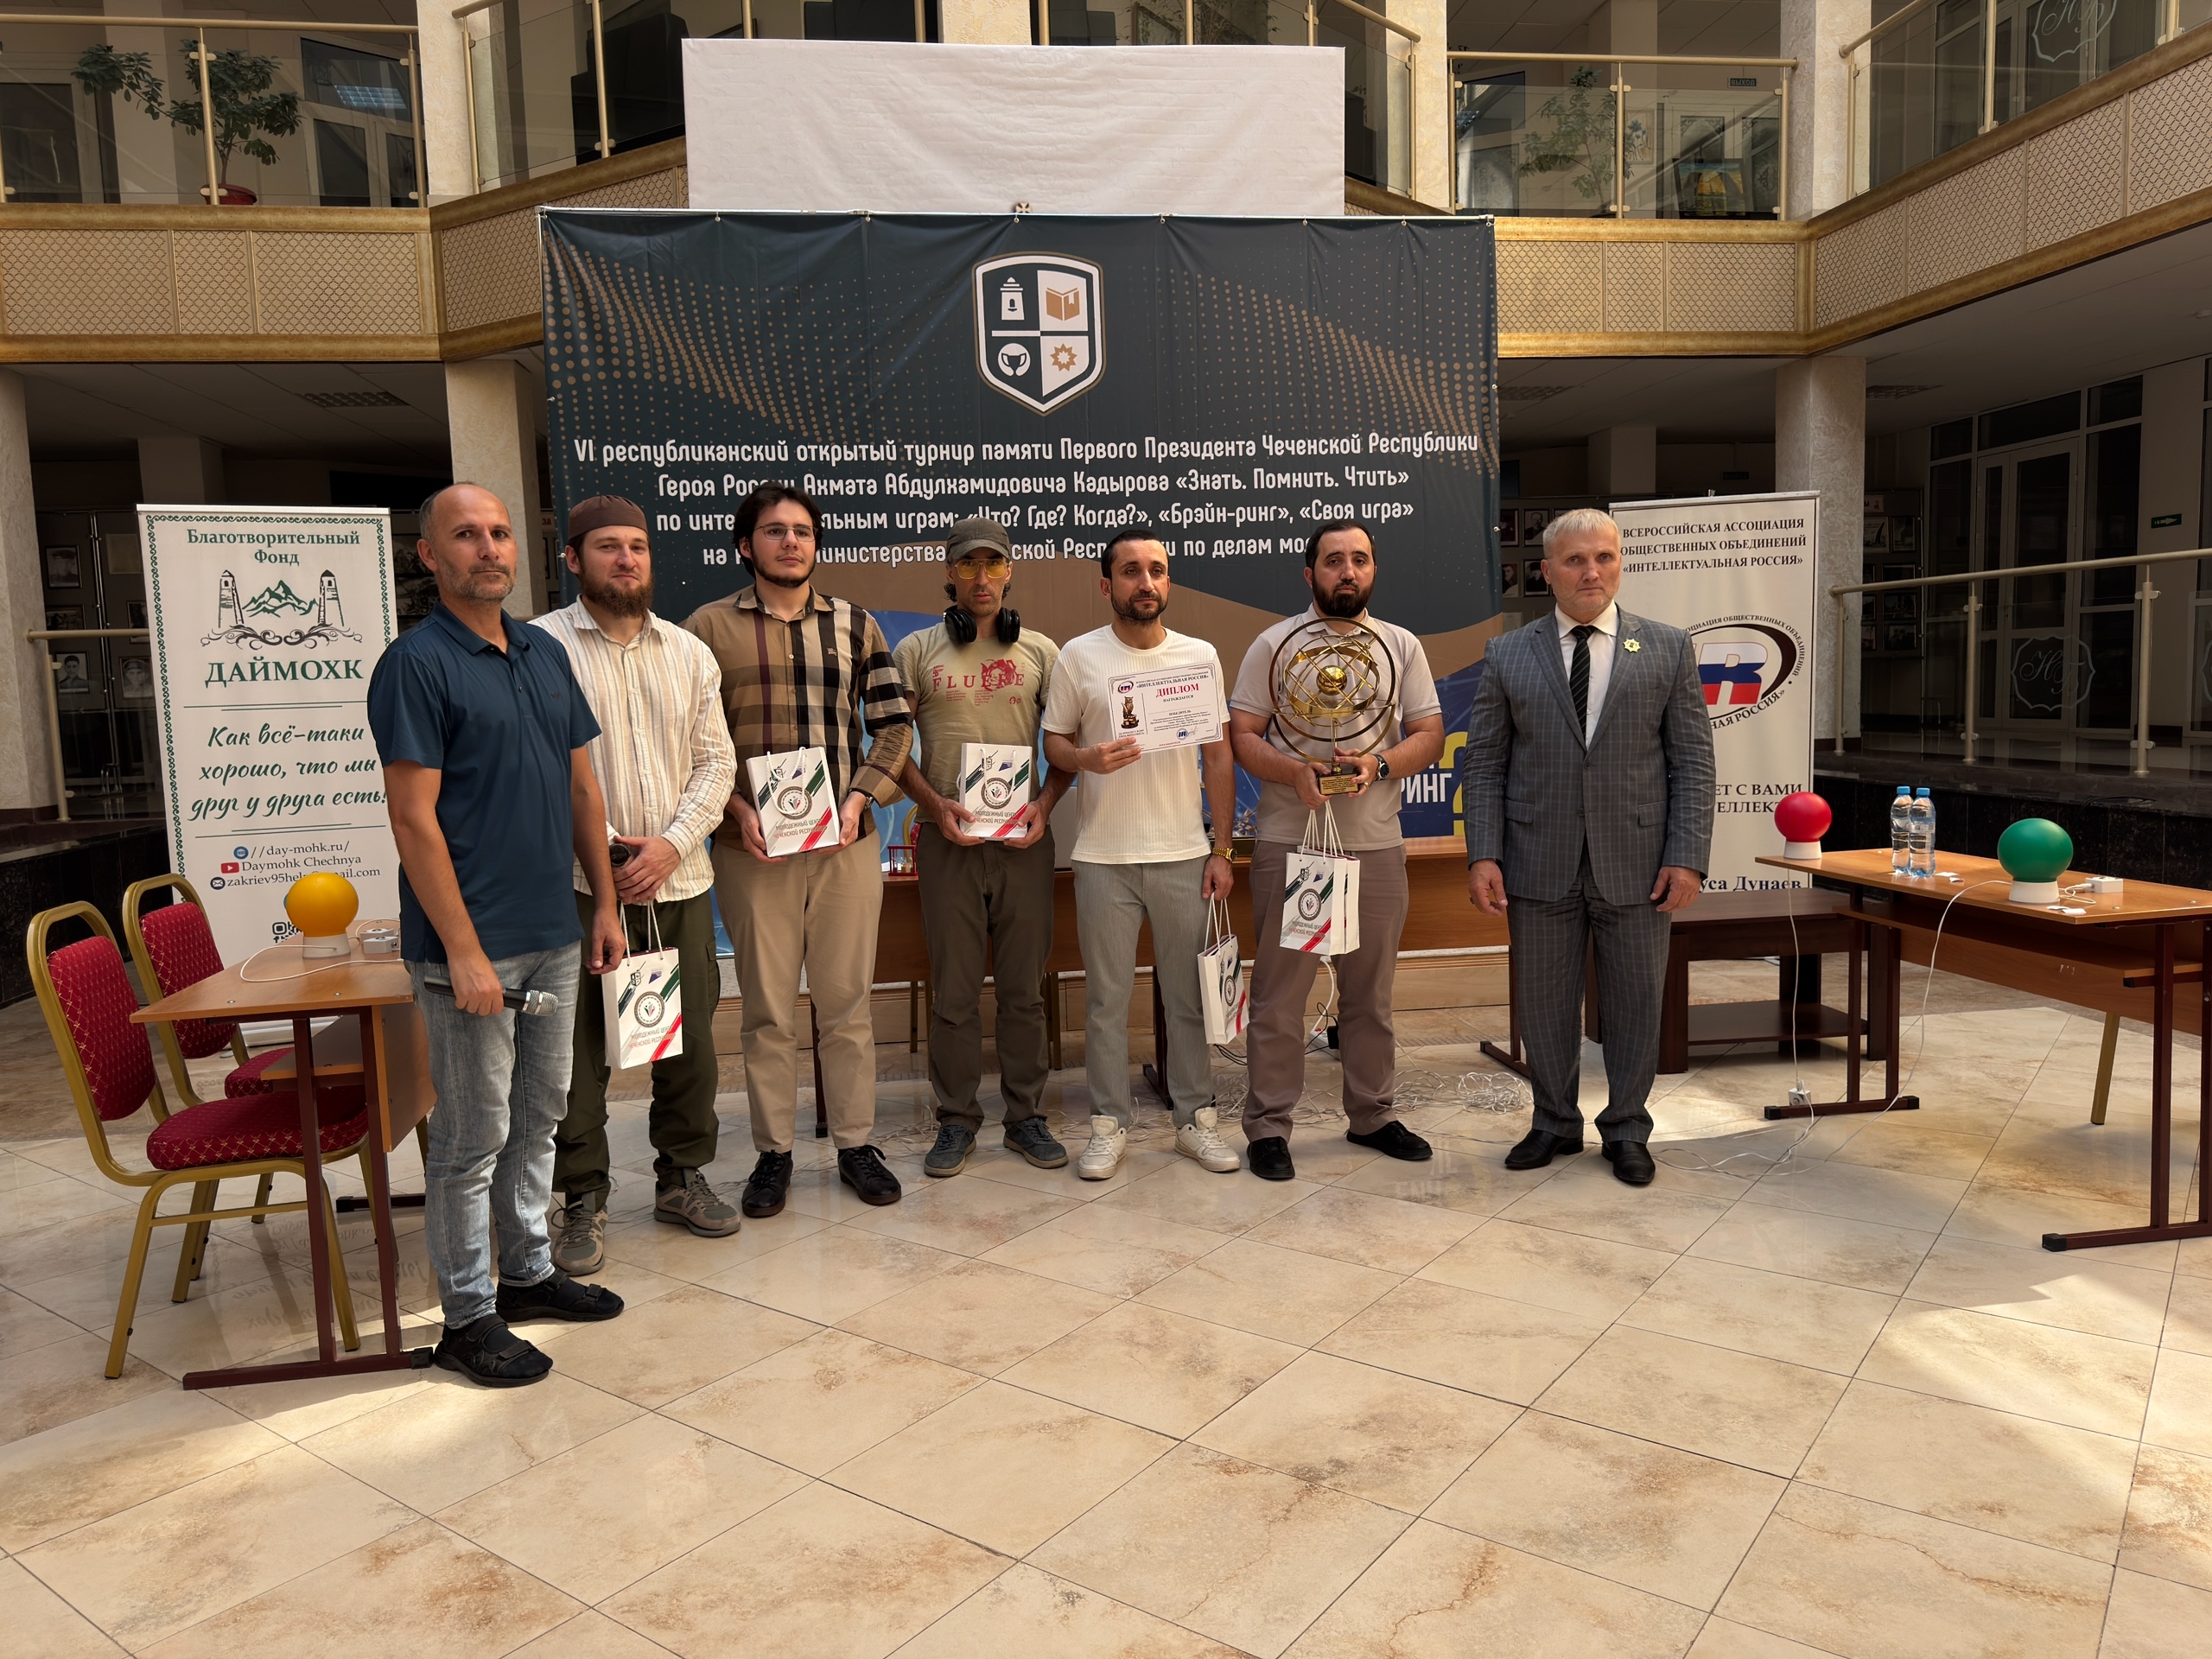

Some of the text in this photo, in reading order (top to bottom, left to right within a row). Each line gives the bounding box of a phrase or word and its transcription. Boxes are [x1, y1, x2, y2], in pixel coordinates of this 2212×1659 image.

[574, 430, 1478, 467] VI республиканский открытый турнир памяти Первого Президента Чеченской Республики
[658, 474, 715, 502] Героя
[803, 473, 879, 498] Ахмата
[885, 473, 1066, 500] Абдулхамидовича
[1073, 471, 1169, 498] Кадырова
[1175, 468, 1247, 491] «Знать.
[1253, 467, 1339, 489] Помнить.
[1344, 465, 1409, 487] Чтить»
[657, 514, 681, 531] по
[1027, 504, 1067, 530] Где?
[1073, 503, 1153, 529] Когда?»,
[1158, 502, 1294, 529] «Брэйн-ринг»,
[1299, 499, 1355, 521] «Своя
[1361, 502, 1414, 524] игра»
[187, 529, 360, 548] Благотворительный
[1623, 518, 1804, 538] ВСЕРОССИЙСКАЯ АССОЦИАЦИЯ
[702, 548, 728, 565] на
[1184, 540, 1205, 556] по
[1211, 538, 1272, 559] делам
[1620, 534, 1807, 556] ОБЩЕСТВЕННЫХ ОБЪЕДИНЕНИЙ
[254, 550, 300, 567] Фонд
[1623, 555, 1803, 573] «ИНТЕЛЛЕКТУАЛЬНАЯ РОССИЯ»
[1723, 614, 1786, 628] ОБЩЕСТВЕННЫХ
[205, 656, 364, 689] ДАЙМОХК
[1155, 683, 1199, 698] ДИПЛОМ
[1736, 690, 1785, 722] РОССИЯ»
[207, 722, 365, 747] Как всё-таки
[199, 758, 377, 786] хорошо, что мы
[187, 790, 387, 821] друг у друга есть!
[242, 855, 361, 874] Daymohk Chechnya
[1700, 876, 1802, 893] уса Дунаев
